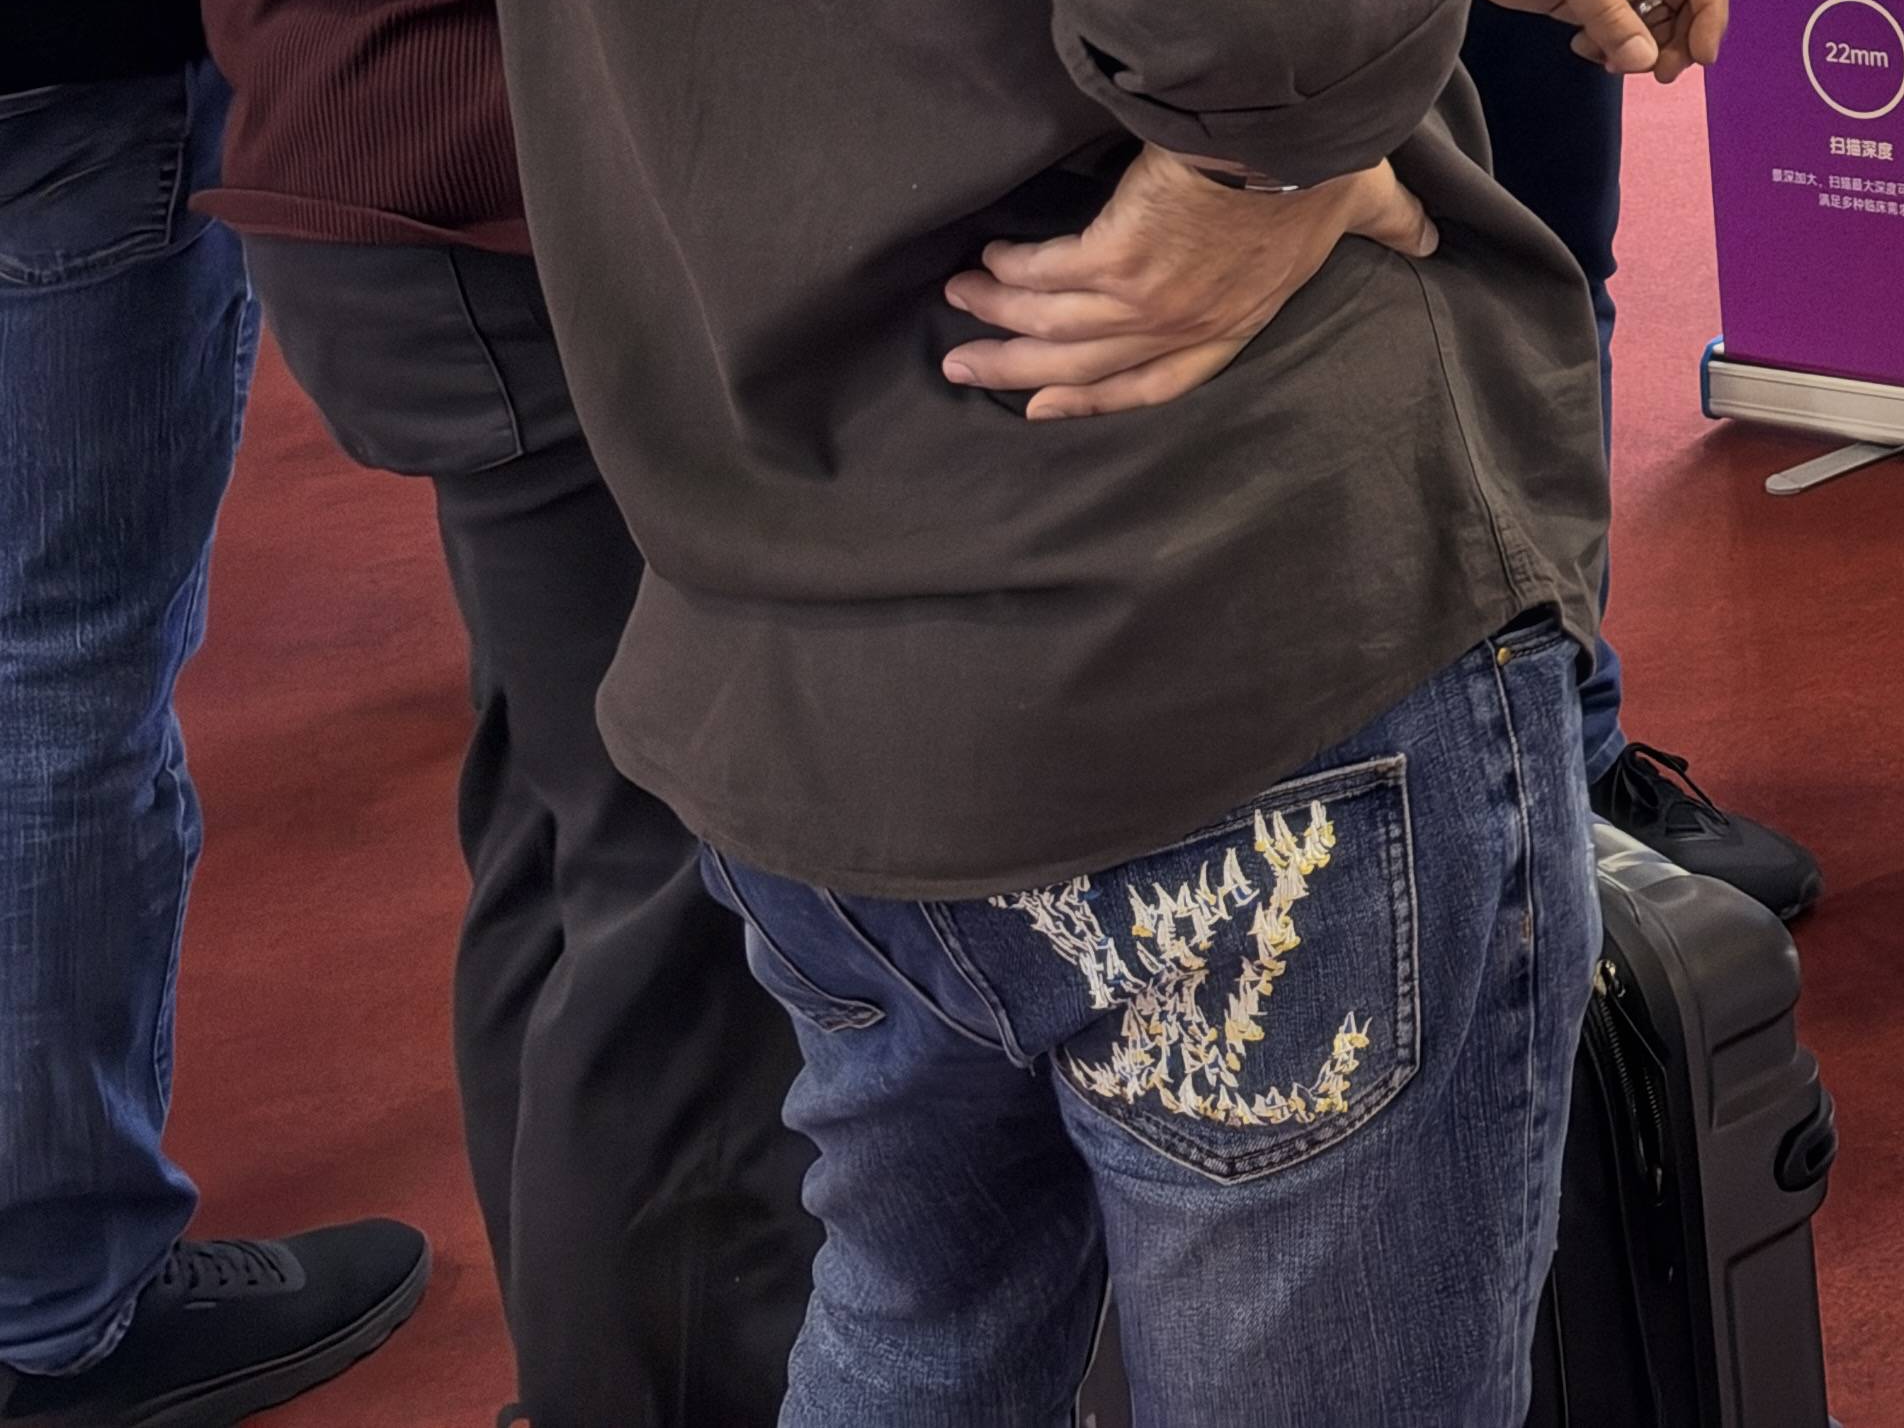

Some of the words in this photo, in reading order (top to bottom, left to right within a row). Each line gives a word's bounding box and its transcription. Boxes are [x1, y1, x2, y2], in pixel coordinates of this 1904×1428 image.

[1825, 41, 1890, 69] 22mm
[1829, 136, 1894, 161] 扫描深度
